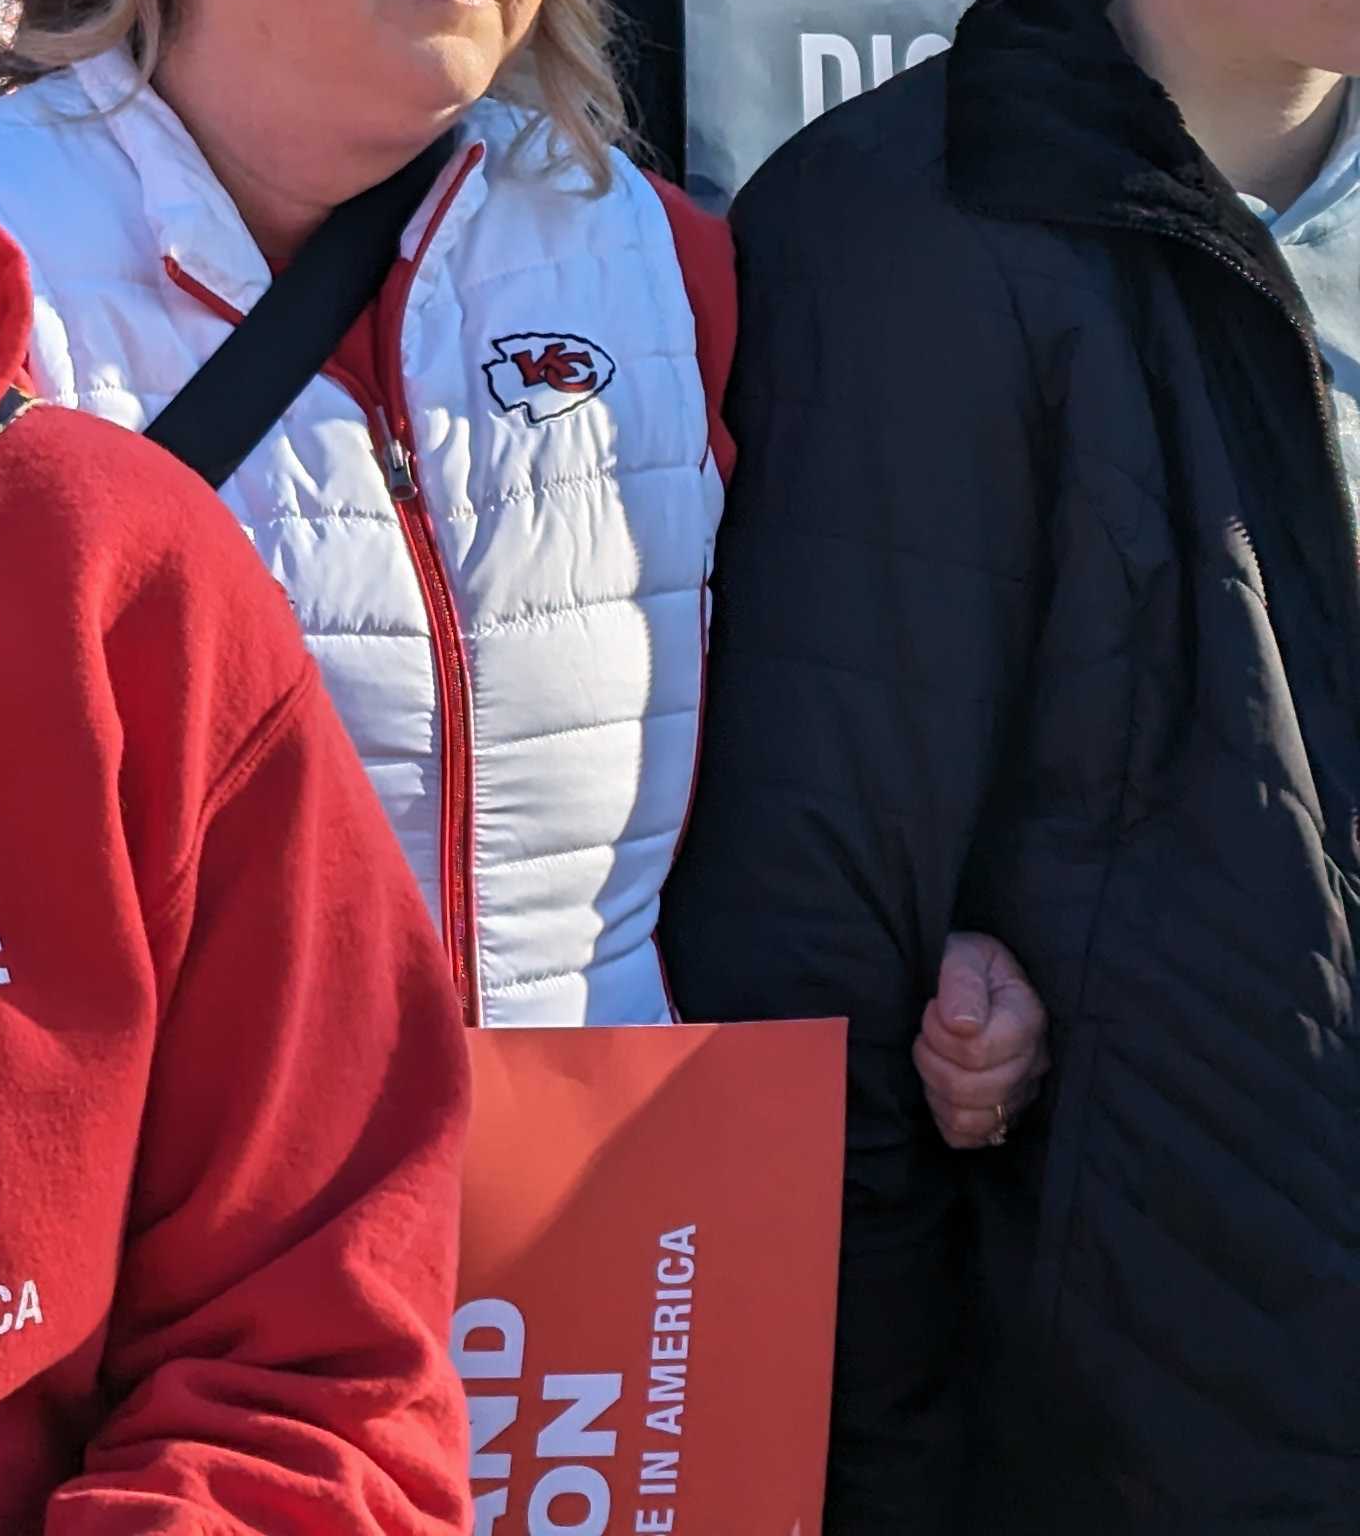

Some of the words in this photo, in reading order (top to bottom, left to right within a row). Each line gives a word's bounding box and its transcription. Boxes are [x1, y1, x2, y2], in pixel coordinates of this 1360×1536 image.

[510, 342, 597, 393] KC
[645, 1224, 696, 1435] AMERICA
[639, 1451, 679, 1495] IN
